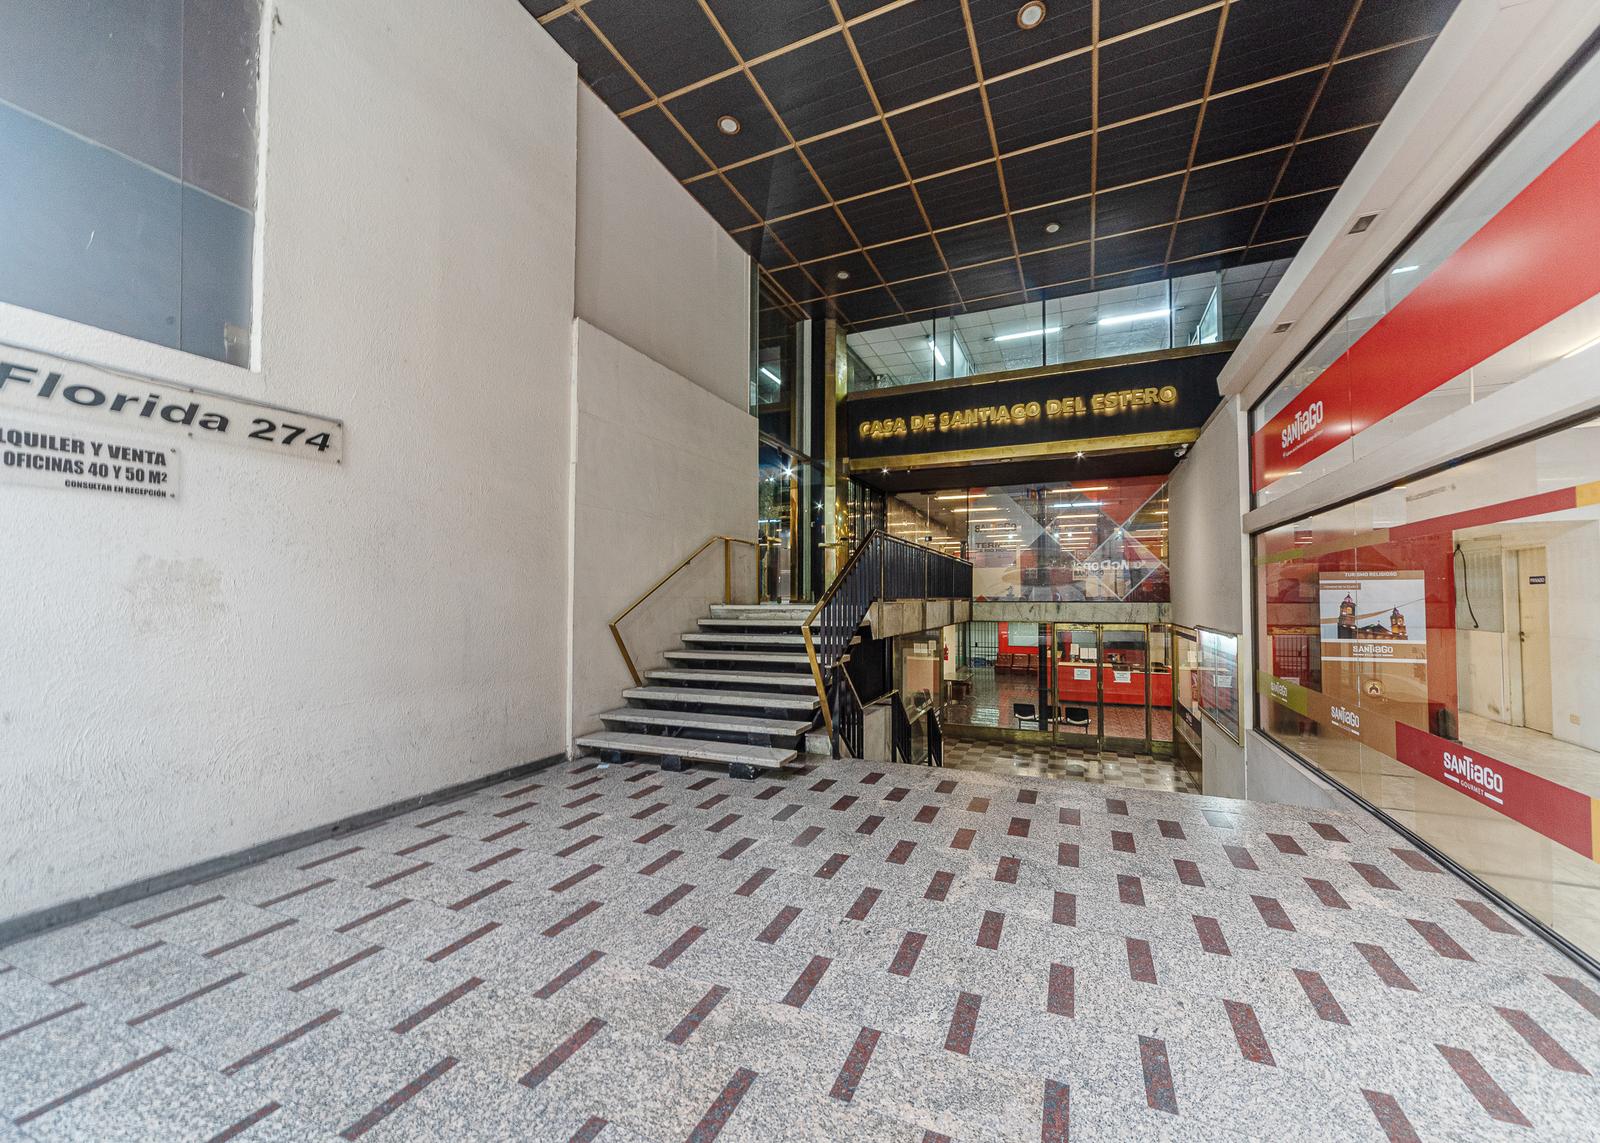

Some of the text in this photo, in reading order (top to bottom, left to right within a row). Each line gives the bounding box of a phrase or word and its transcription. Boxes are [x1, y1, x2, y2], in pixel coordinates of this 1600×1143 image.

[0, 361, 331, 452] Florida 274
[859, 385, 1177, 437] CASA DE SANTIAGO DEL ESTERO
[3, 450, 84, 475] OFICINAS
[88, 462, 109, 478] 40
[113, 465, 122, 479] Y
[125, 467, 145, 482] 50
[90, 441, 103, 457] Y
[107, 444, 167, 466] VENTA
[64, 479, 167, 498] CONSULTAR EN RECEPCIÓN
[1460, 780, 1485, 796] GOURMET
